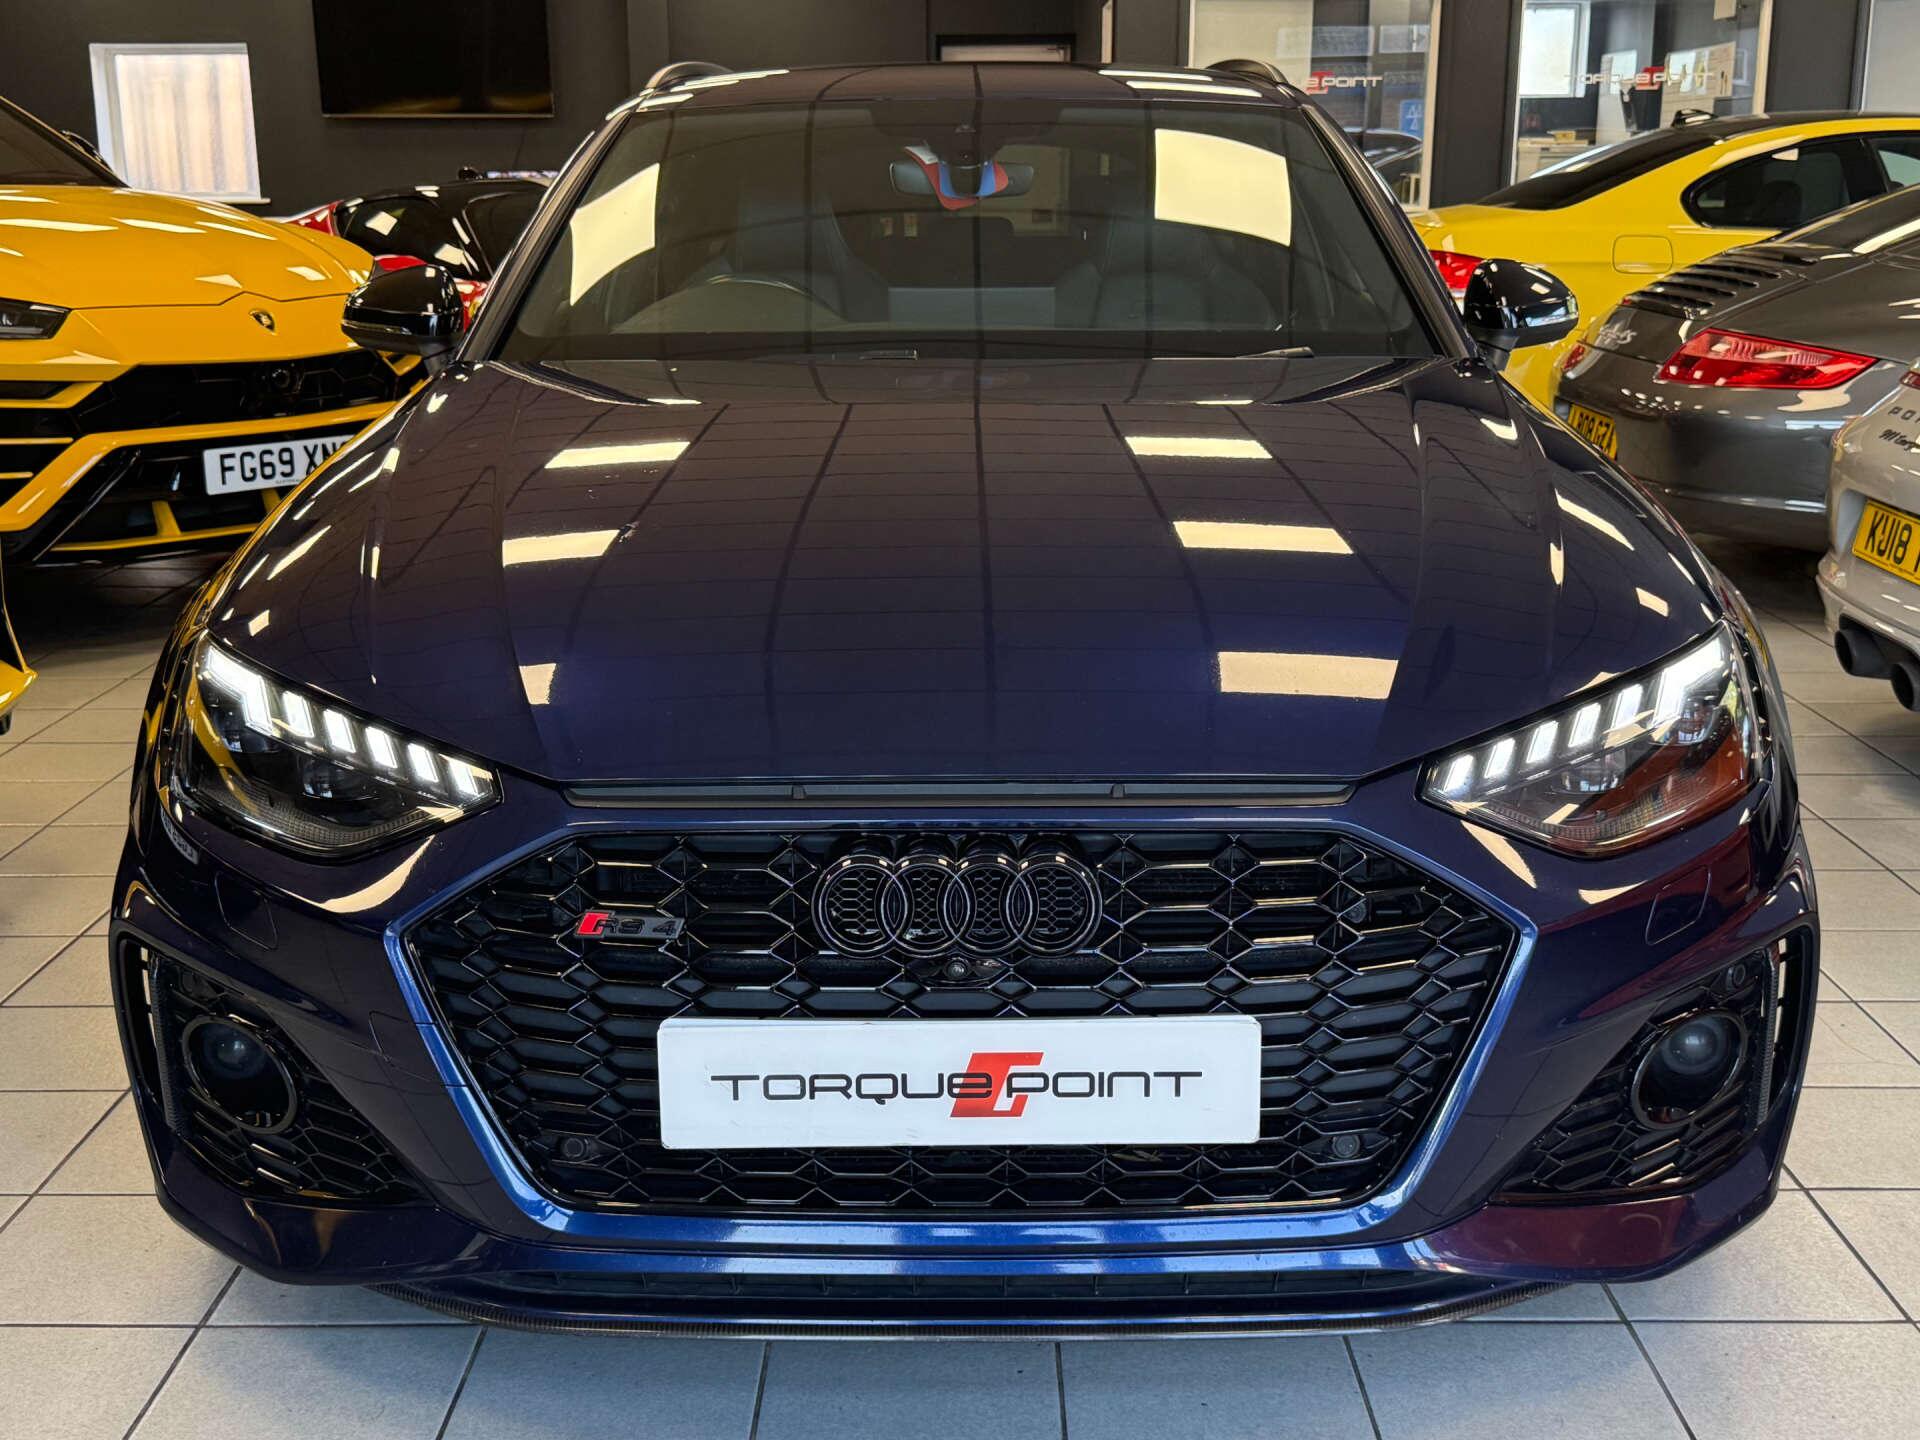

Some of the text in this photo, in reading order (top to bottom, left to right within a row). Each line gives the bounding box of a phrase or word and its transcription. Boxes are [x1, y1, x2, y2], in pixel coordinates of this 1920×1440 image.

[219, 441, 346, 486] FG69 XN
[1866, 511, 1912, 565] KU18
